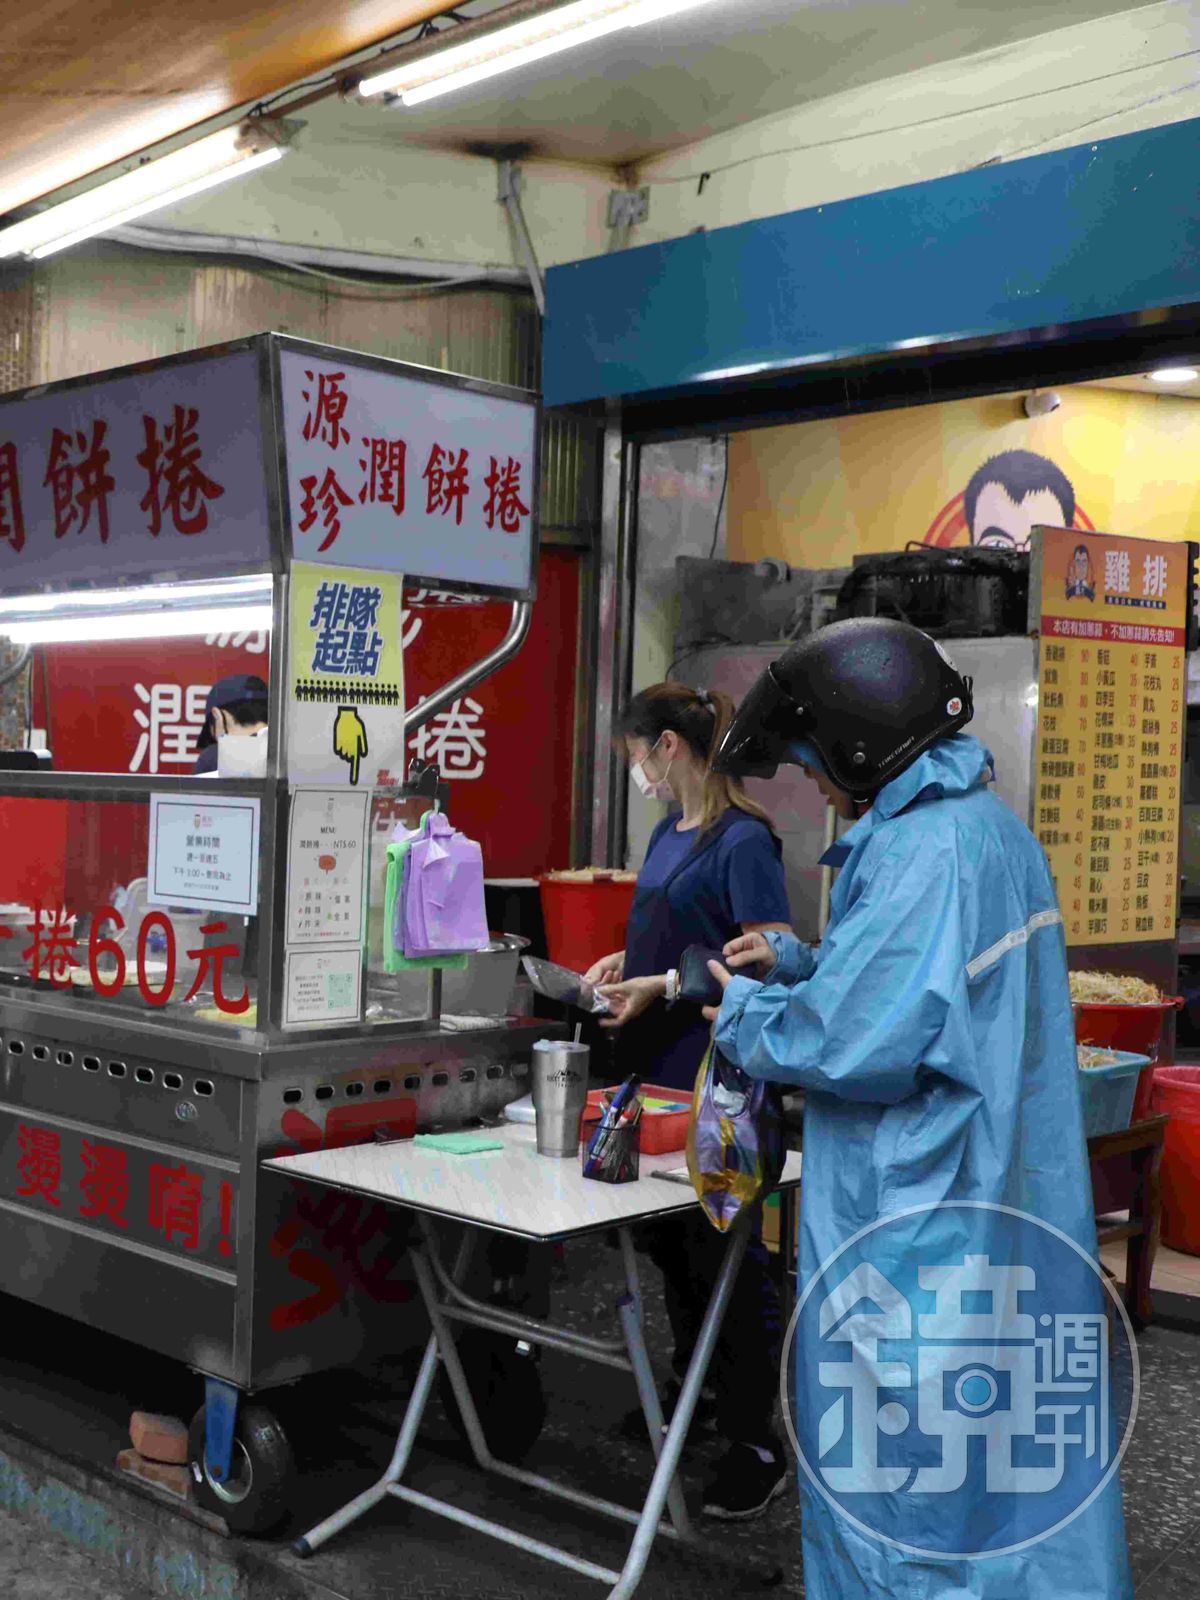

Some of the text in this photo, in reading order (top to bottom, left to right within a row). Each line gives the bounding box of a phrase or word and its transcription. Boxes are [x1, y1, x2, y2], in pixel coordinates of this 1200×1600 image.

[358, 437, 529, 534] 潤餅捲
[1104, 551, 1168, 597] 雞排
[310, 582, 382, 630] 排隊
[312, 629, 383, 675] 起點
